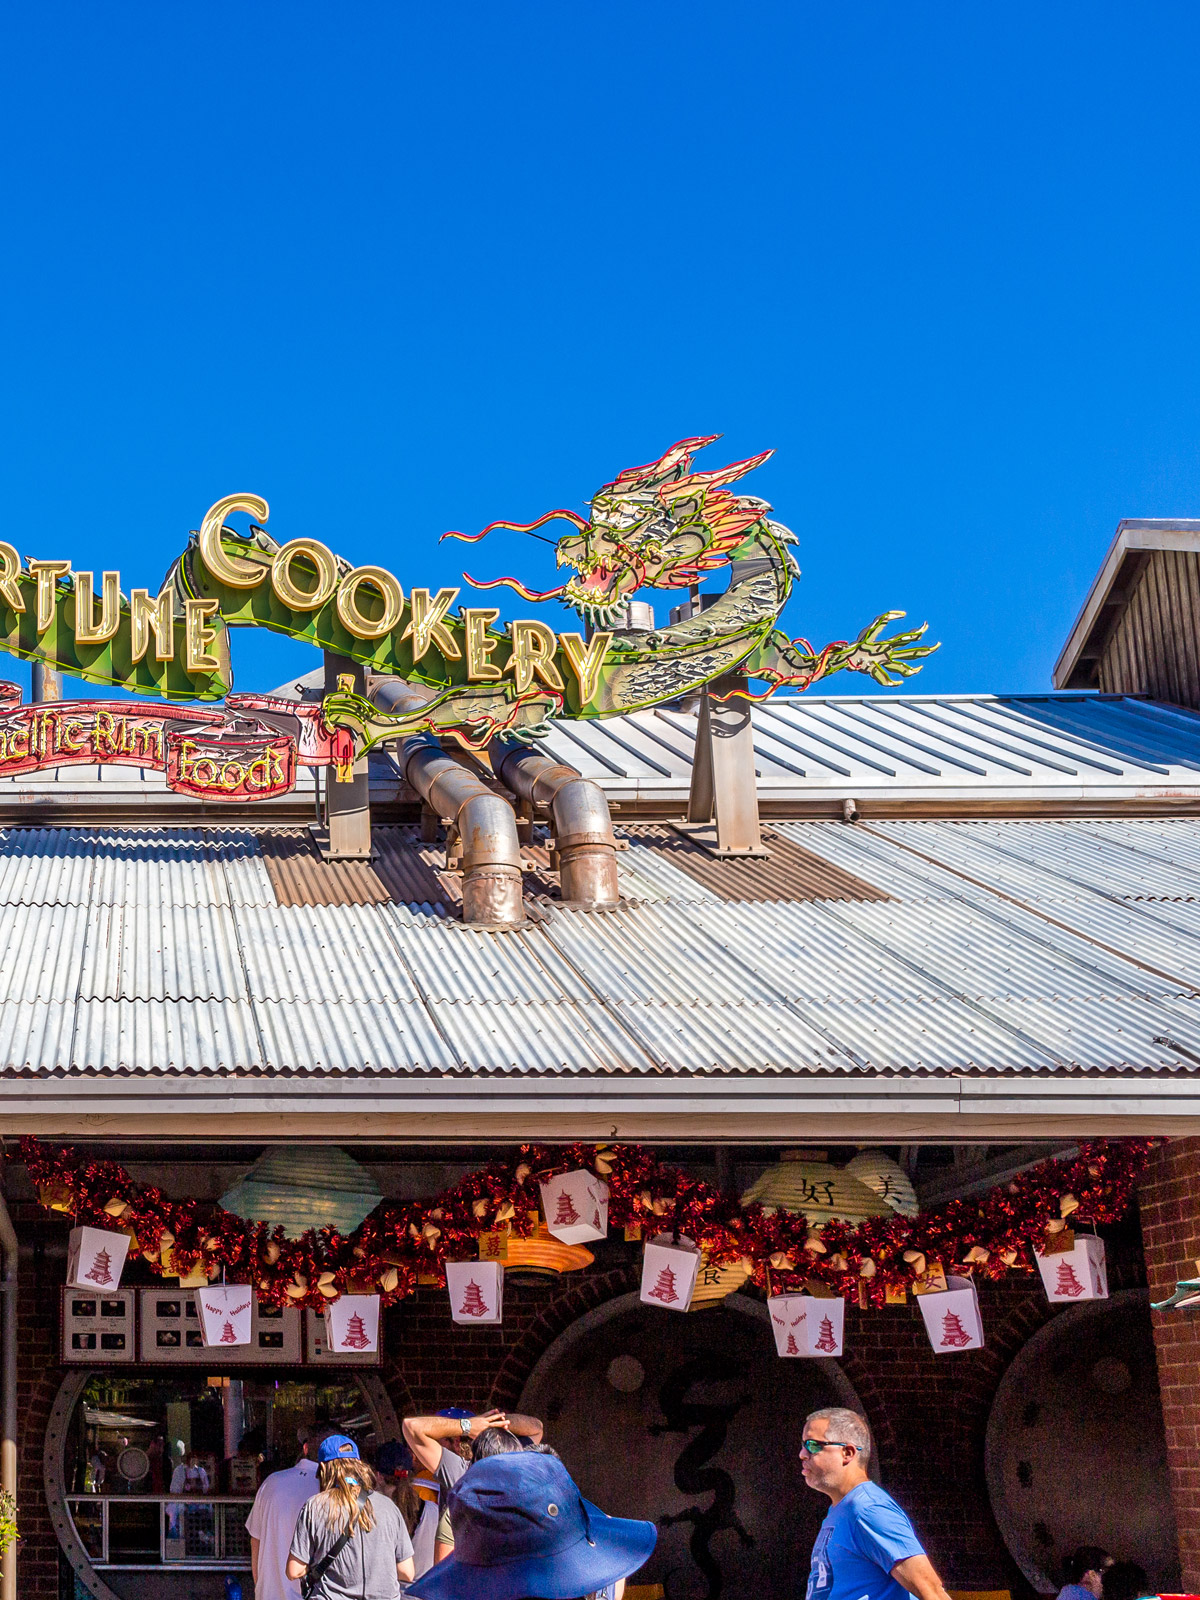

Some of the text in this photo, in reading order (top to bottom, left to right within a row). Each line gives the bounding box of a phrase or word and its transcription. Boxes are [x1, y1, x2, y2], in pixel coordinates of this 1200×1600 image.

[200, 492, 614, 707] COOKERY
[795, 1178, 843, 1206] 好
[876, 1175, 903, 1204] 美
[205, 1301, 252, 1316] Happy Holidays
[772, 1312, 808, 1327] Happy Holidays
